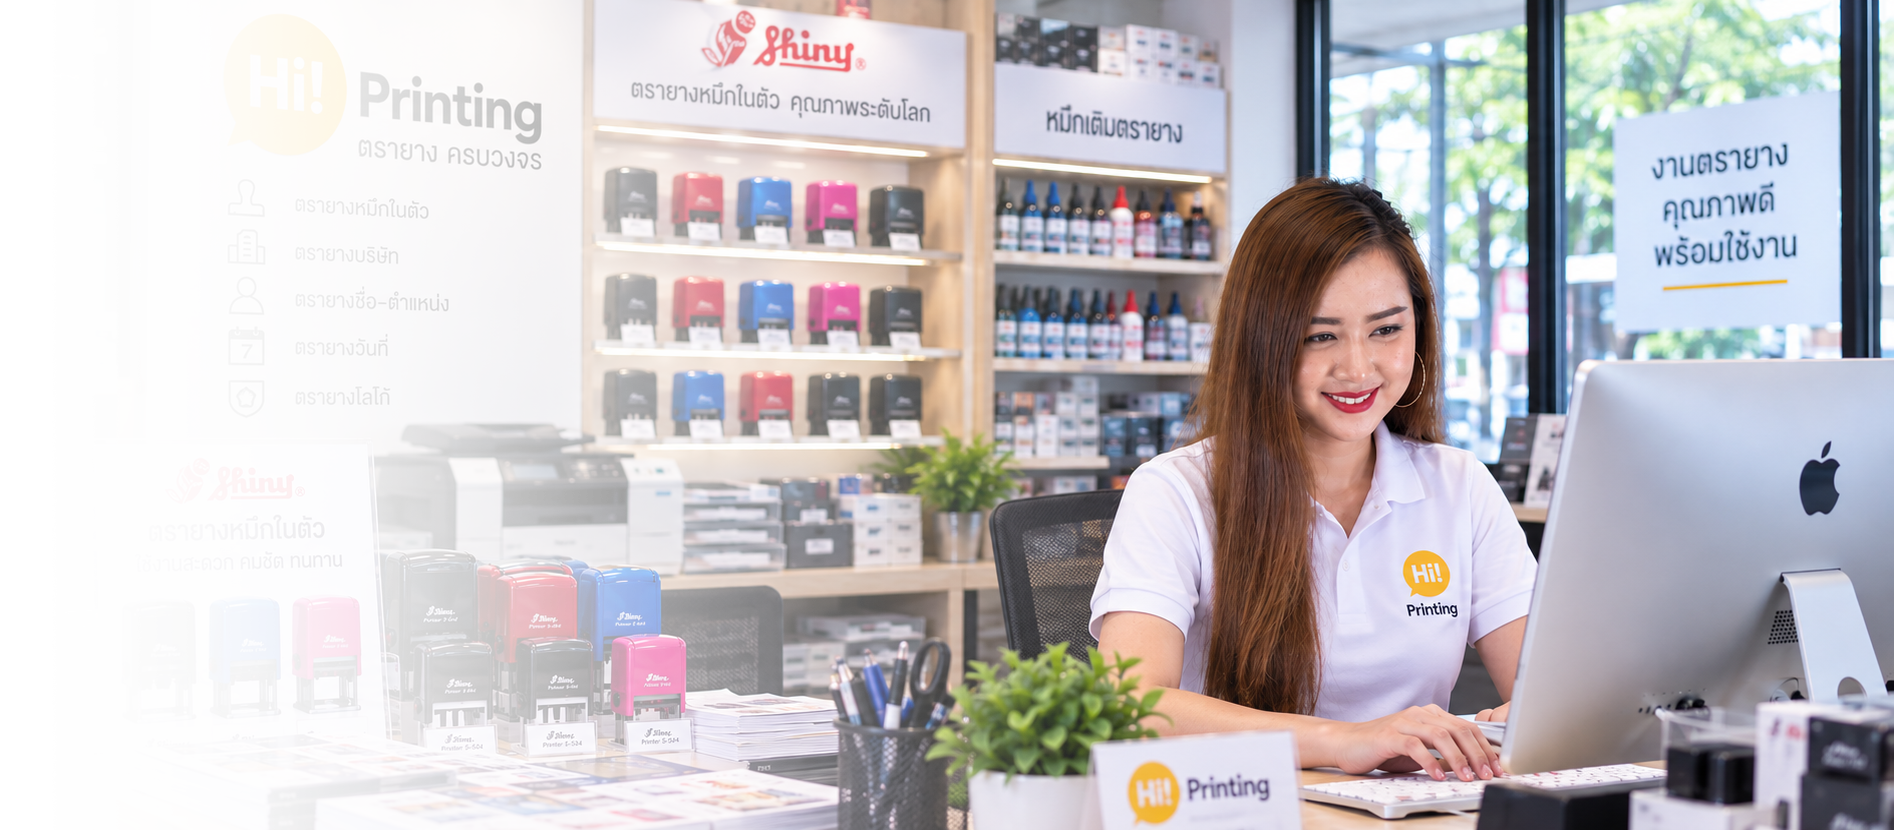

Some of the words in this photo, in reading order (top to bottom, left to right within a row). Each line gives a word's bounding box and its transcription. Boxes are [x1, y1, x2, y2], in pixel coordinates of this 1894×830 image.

[752, 24, 854, 73] Shiny
[248, 53, 324, 115] Hi!
[630, 80, 781, 110] ตรายางหมึกในตัว
[359, 71, 542, 146] Printing
[1046, 104, 1183, 144] หมึกเติมตรายาง
[358, 138, 438, 164] ตรายาง
[447, 143, 542, 170] ครบวงจร
[1651, 142, 1788, 180] งานตรายาง
[295, 197, 430, 220] ตรายางหมึกในตัว
[1663, 181, 1775, 231] คุณภาพดี
[295, 246, 399, 265] ตรายางบริษัท
[1654, 230, 1797, 267] พร้อมใช้งาน
[241, 344, 254, 360] 7
[295, 334, 389, 357] ตรายางวันที่
[207, 466, 295, 502] Shiny
[148, 514, 326, 543] ตรายางหมึกในตัว
[134, 553, 234, 573] ใช้งานสะดวก
[290, 553, 343, 568] ทนทาน
[1411, 562, 1443, 584] Hi!
[1406, 602, 1459, 618] Printing
[1135, 777, 1174, 808] Hi!
[1187, 774, 1270, 802] Printing
